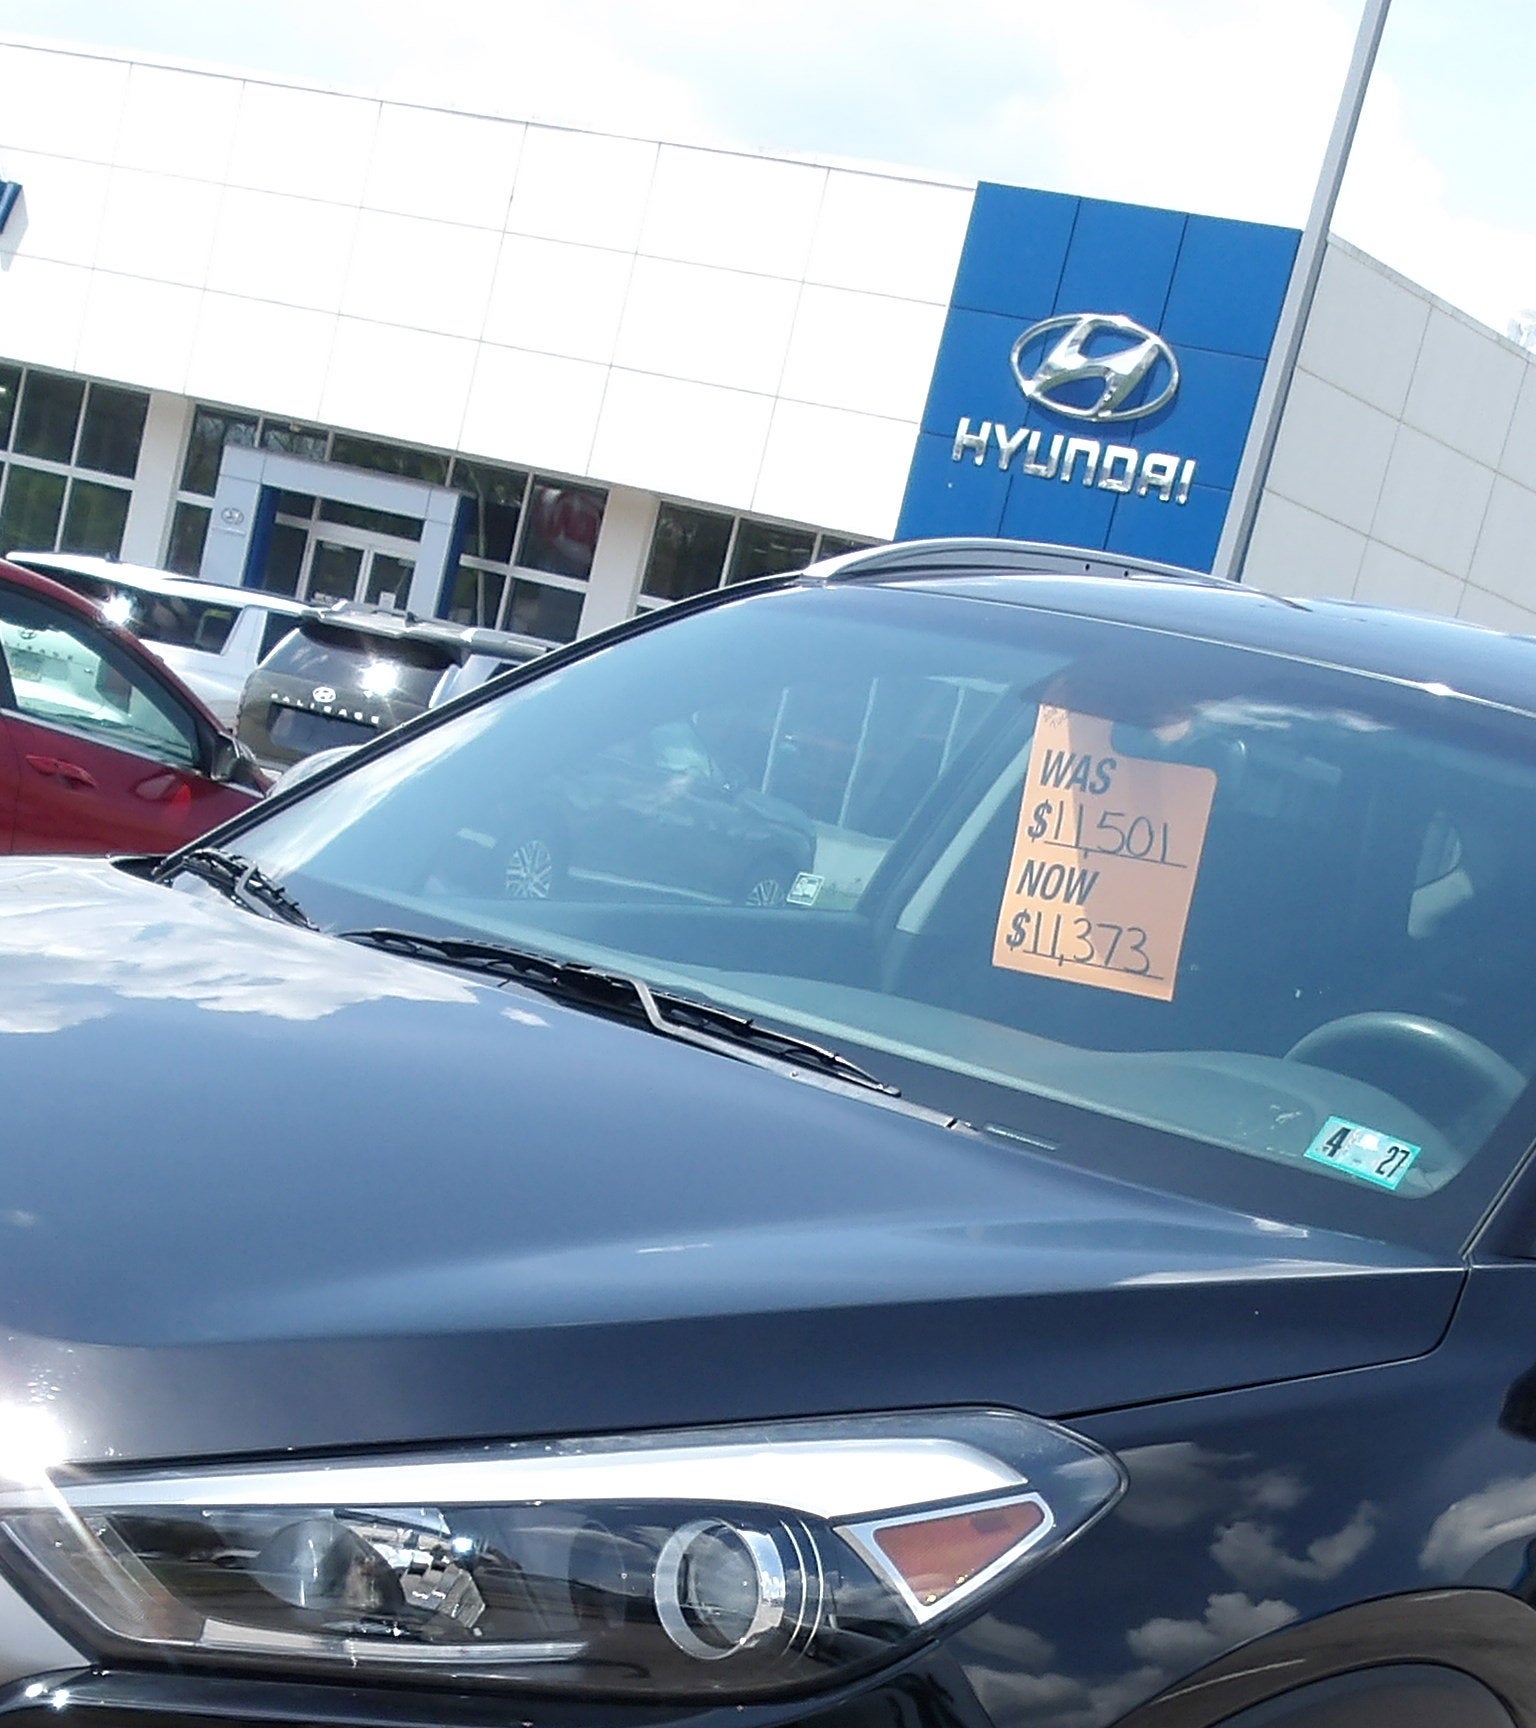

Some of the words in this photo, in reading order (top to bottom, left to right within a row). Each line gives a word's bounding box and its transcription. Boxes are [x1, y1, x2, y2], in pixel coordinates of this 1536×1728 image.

[952, 417, 1197, 505] HYUNDAI
[1039, 748, 1117, 795] WAS
[1027, 799, 1169, 864] $11,501
[1016, 859, 1100, 906] NOW
[1005, 908, 1150, 976] $11,373
[1323, 1127, 1352, 1158] 4
[1375, 1145, 1411, 1179] 27
